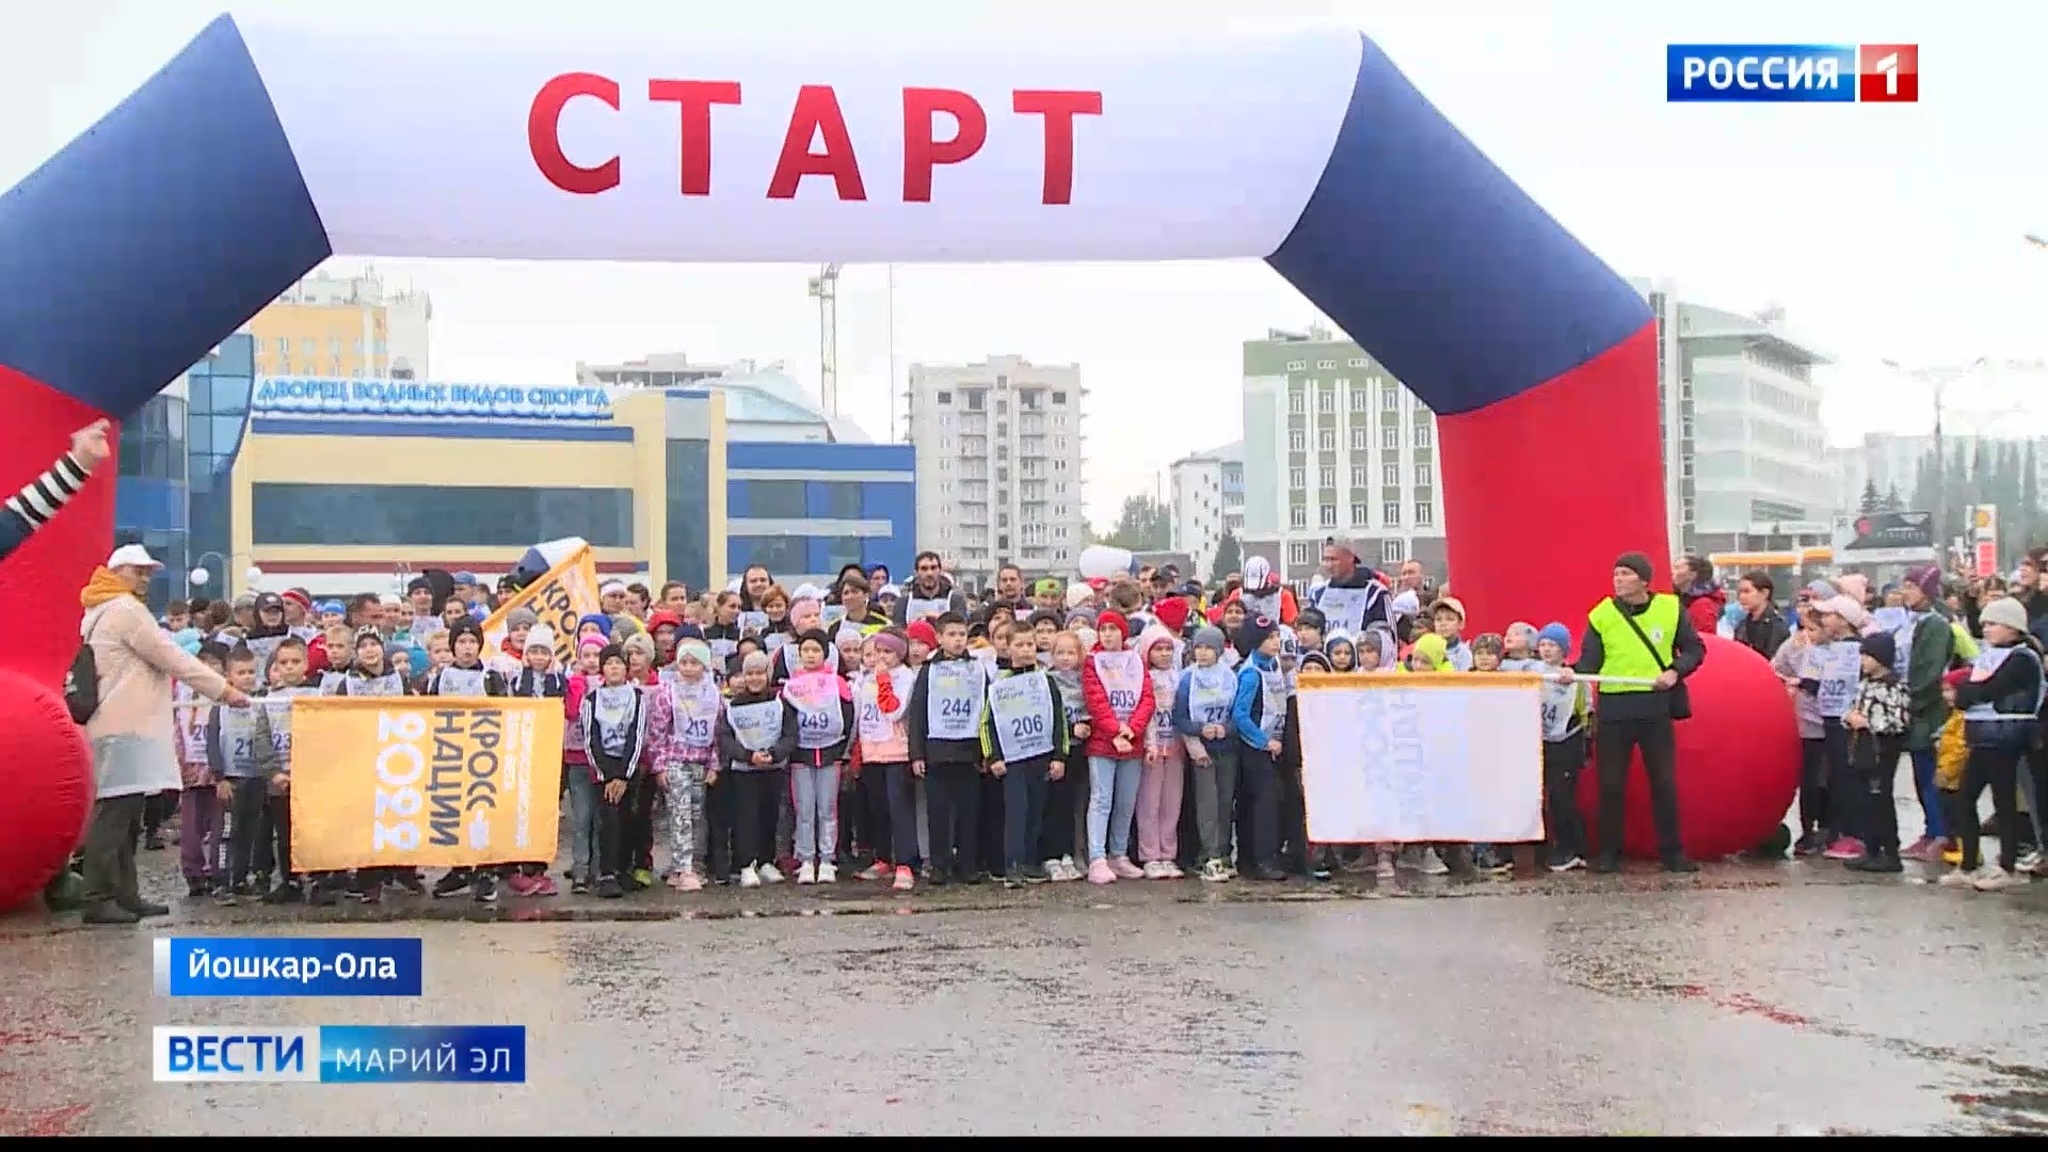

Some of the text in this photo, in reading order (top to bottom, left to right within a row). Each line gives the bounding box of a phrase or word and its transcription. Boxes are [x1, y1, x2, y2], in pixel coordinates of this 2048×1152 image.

[528, 72, 1103, 205] СТАРТ
[257, 379, 610, 407] ДВОРЕЦ ВОДНЫХ ВИДОВ СПОРТА
[941, 699, 971, 717] 244
[1110, 690, 1136, 707] 603
[685, 717, 708, 737] 213
[801, 712, 829, 729] 249
[1011, 715, 1043, 737] 206
[465, 709, 502, 811] КРОСС
[372, 711, 427, 851] 2022
[425, 710, 465, 847] НАЦИИ
